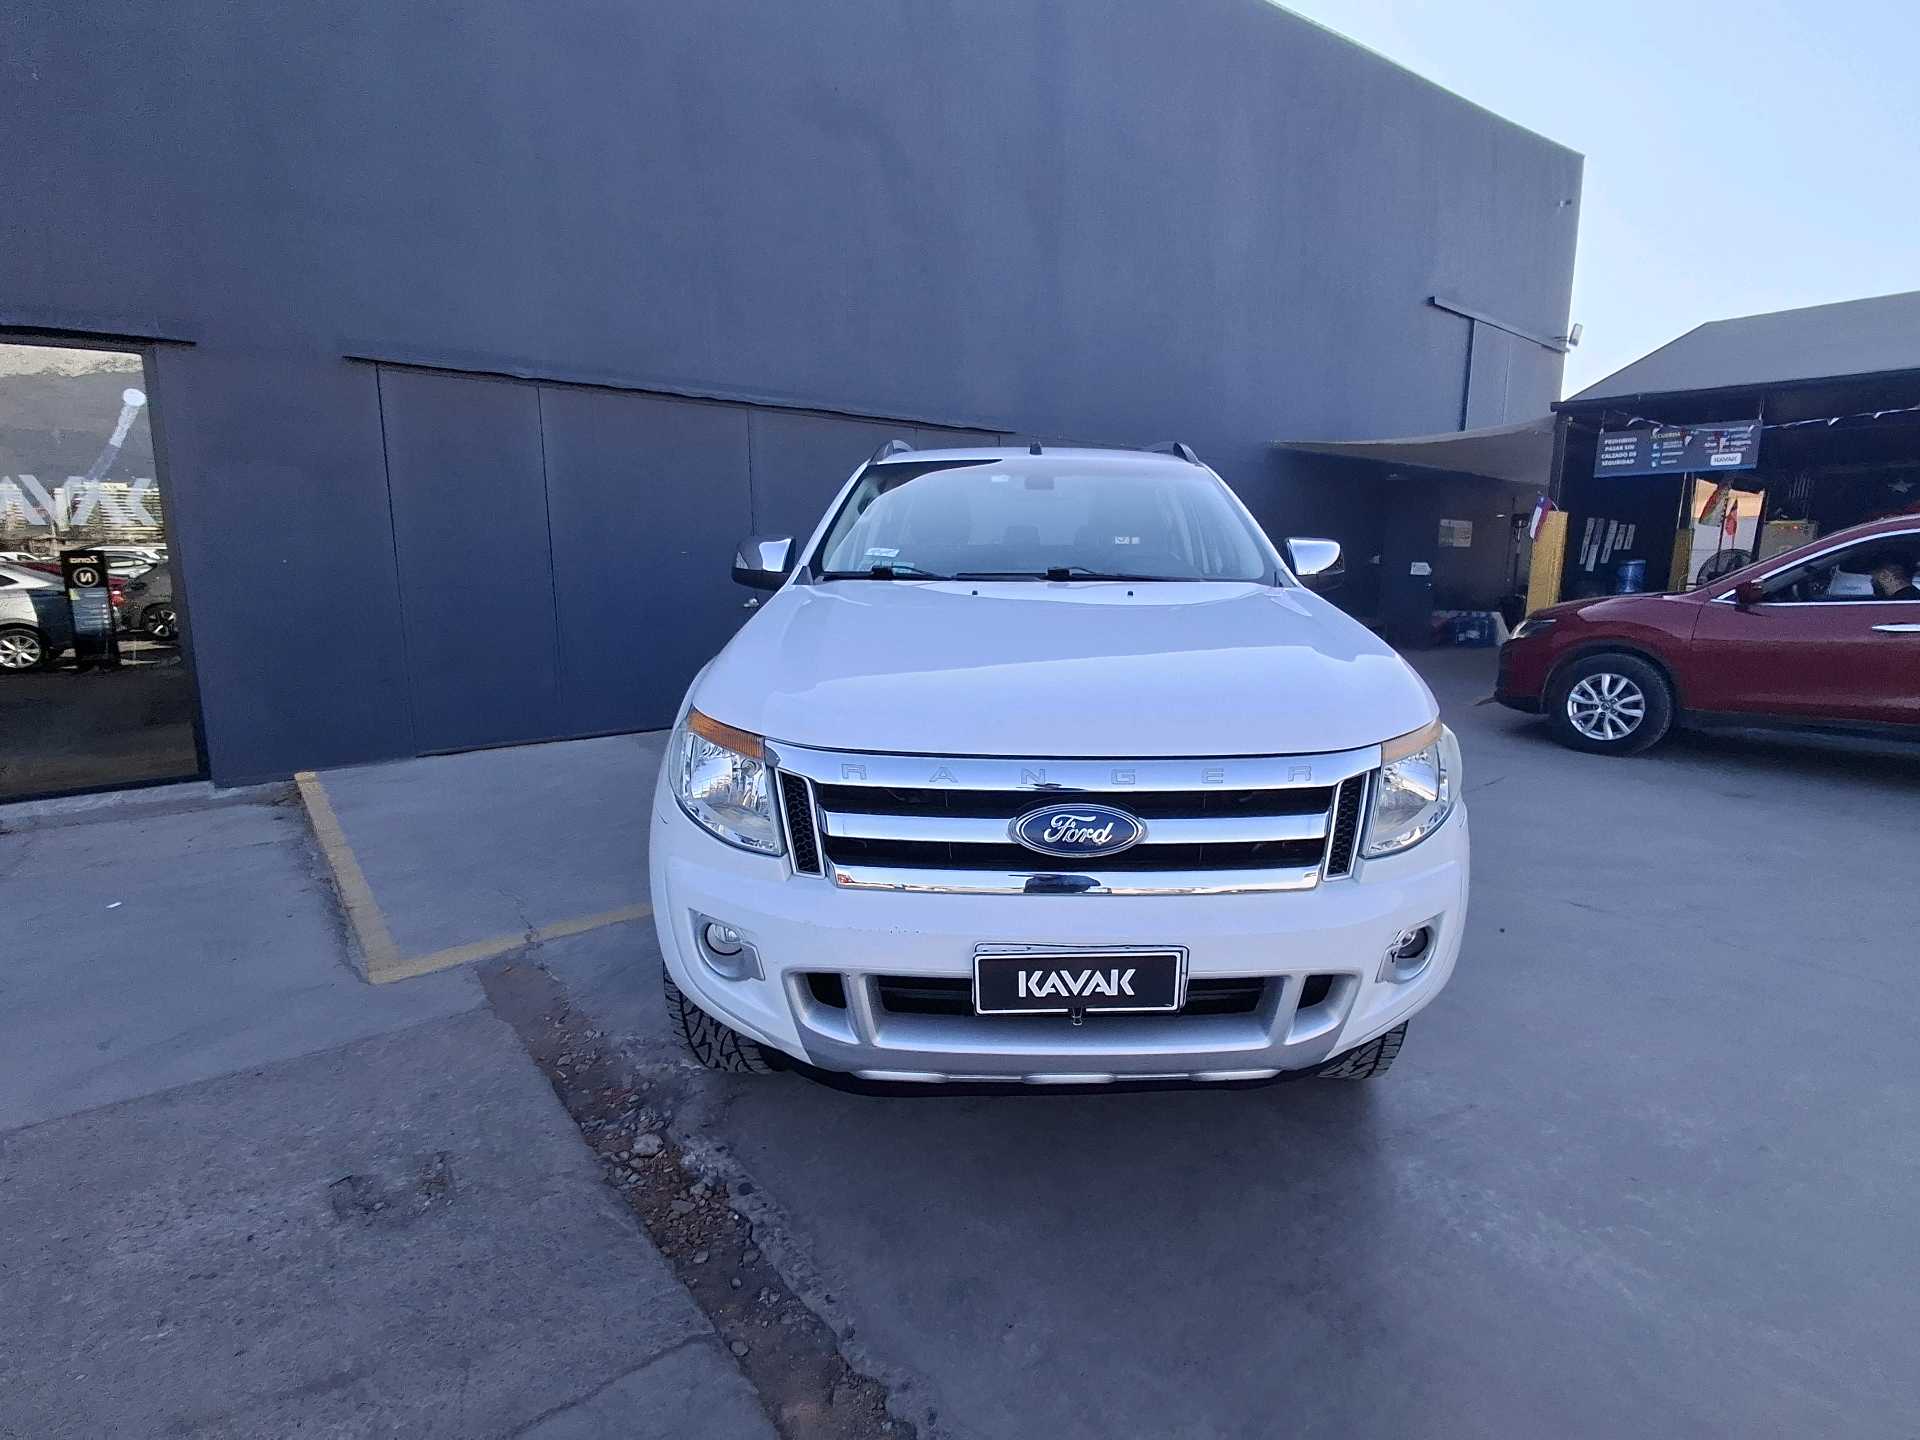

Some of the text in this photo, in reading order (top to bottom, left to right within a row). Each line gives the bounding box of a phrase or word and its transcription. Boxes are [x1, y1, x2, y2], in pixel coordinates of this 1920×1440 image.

[840, 763, 1313, 785] RANGER
[1043, 814, 1115, 845] Ford
[1018, 968, 1137, 998] KAVAK
